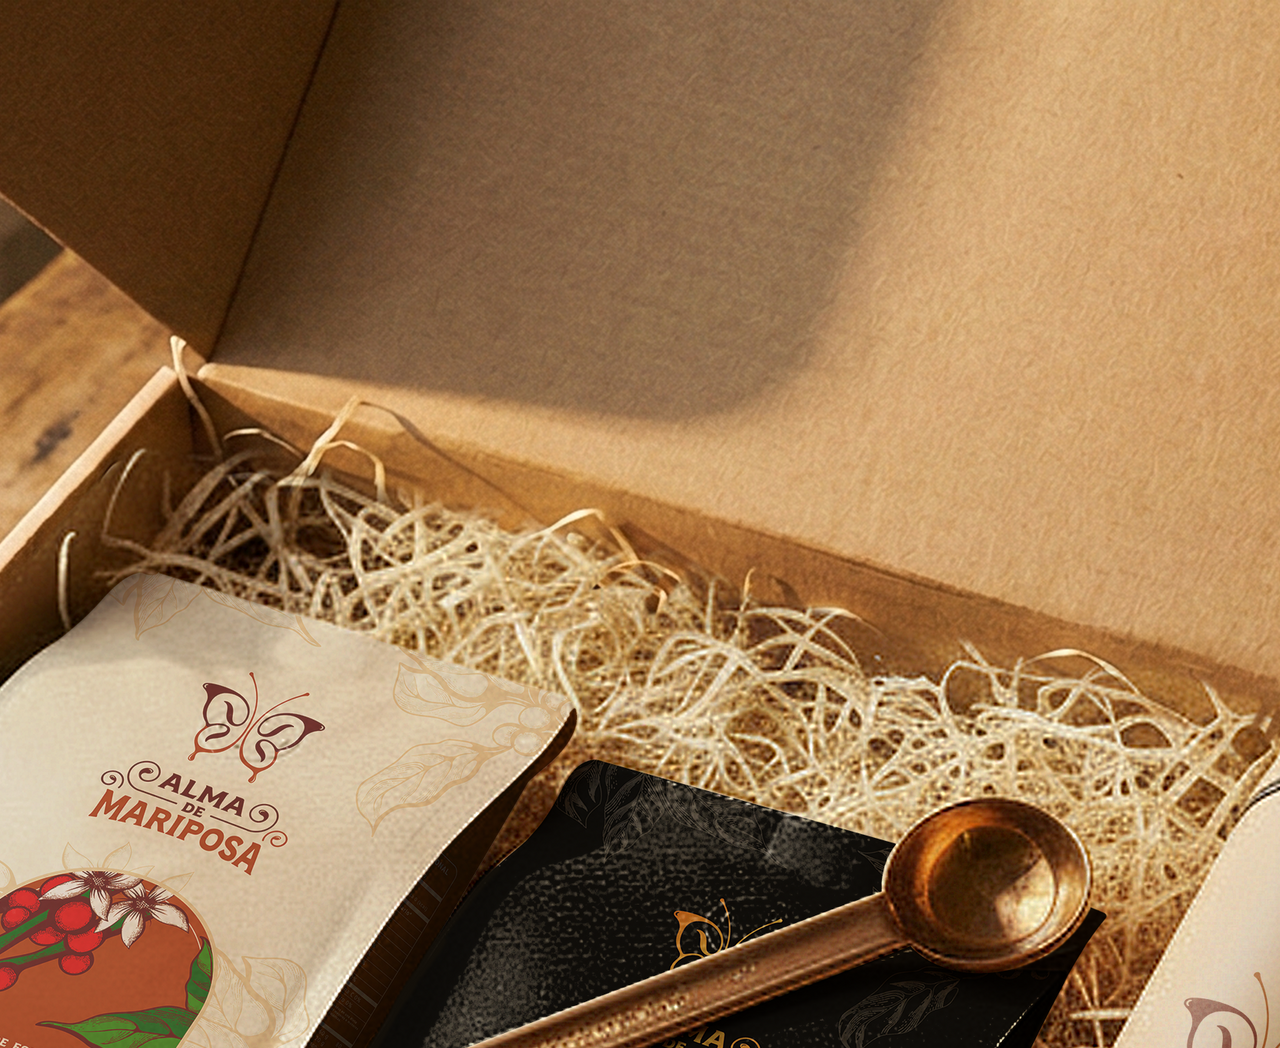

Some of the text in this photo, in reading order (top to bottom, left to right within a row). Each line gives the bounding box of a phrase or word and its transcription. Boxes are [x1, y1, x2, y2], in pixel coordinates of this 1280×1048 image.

[158, 773, 245, 817] ALMA
[181, 802, 205, 818] DE
[88, 788, 262, 876] MARIPOSA
